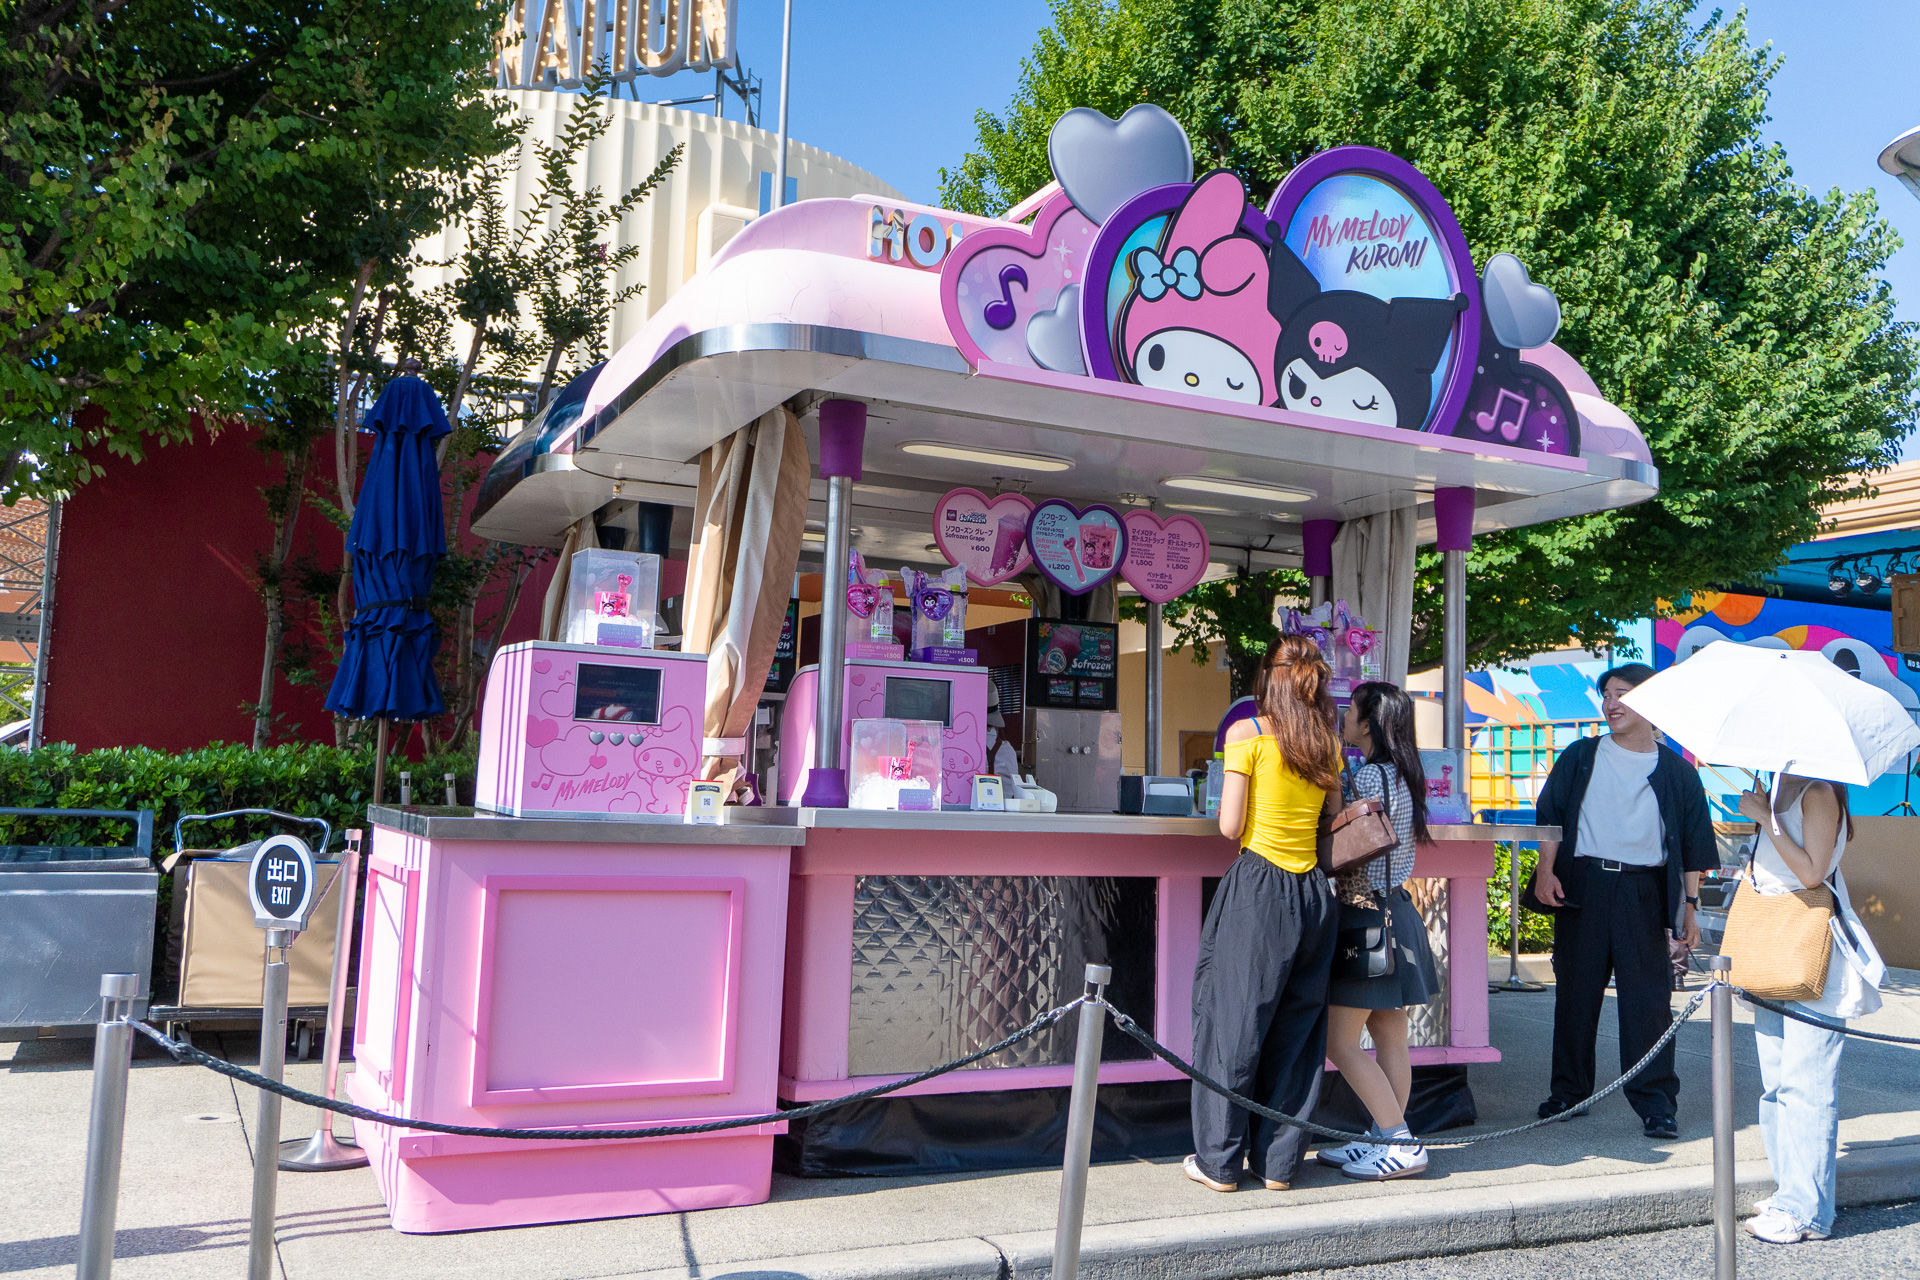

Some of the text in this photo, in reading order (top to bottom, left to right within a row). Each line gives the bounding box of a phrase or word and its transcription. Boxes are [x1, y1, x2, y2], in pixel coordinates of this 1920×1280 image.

[1302, 208, 1414, 257] MY MELODY
[1345, 236, 1429, 275] KUROMI
[959, 513, 986, 524] Sofrozen
[1041, 512, 1068, 522] ソフローズン
[945, 525, 994, 537] ソフローズン グレープ
[945, 532, 985, 542] Sofrozen Grape
[1131, 528, 1158, 537] マイメロディ
[1167, 532, 1180, 540] クロミ
[1147, 572, 1173, 580] ペットボトル
[1071, 658, 1112, 670] Sofrozen
[552, 771, 635, 807] MY MELODY
[266, 857, 299, 883] 出口
[271, 885, 292, 905] EXIT
